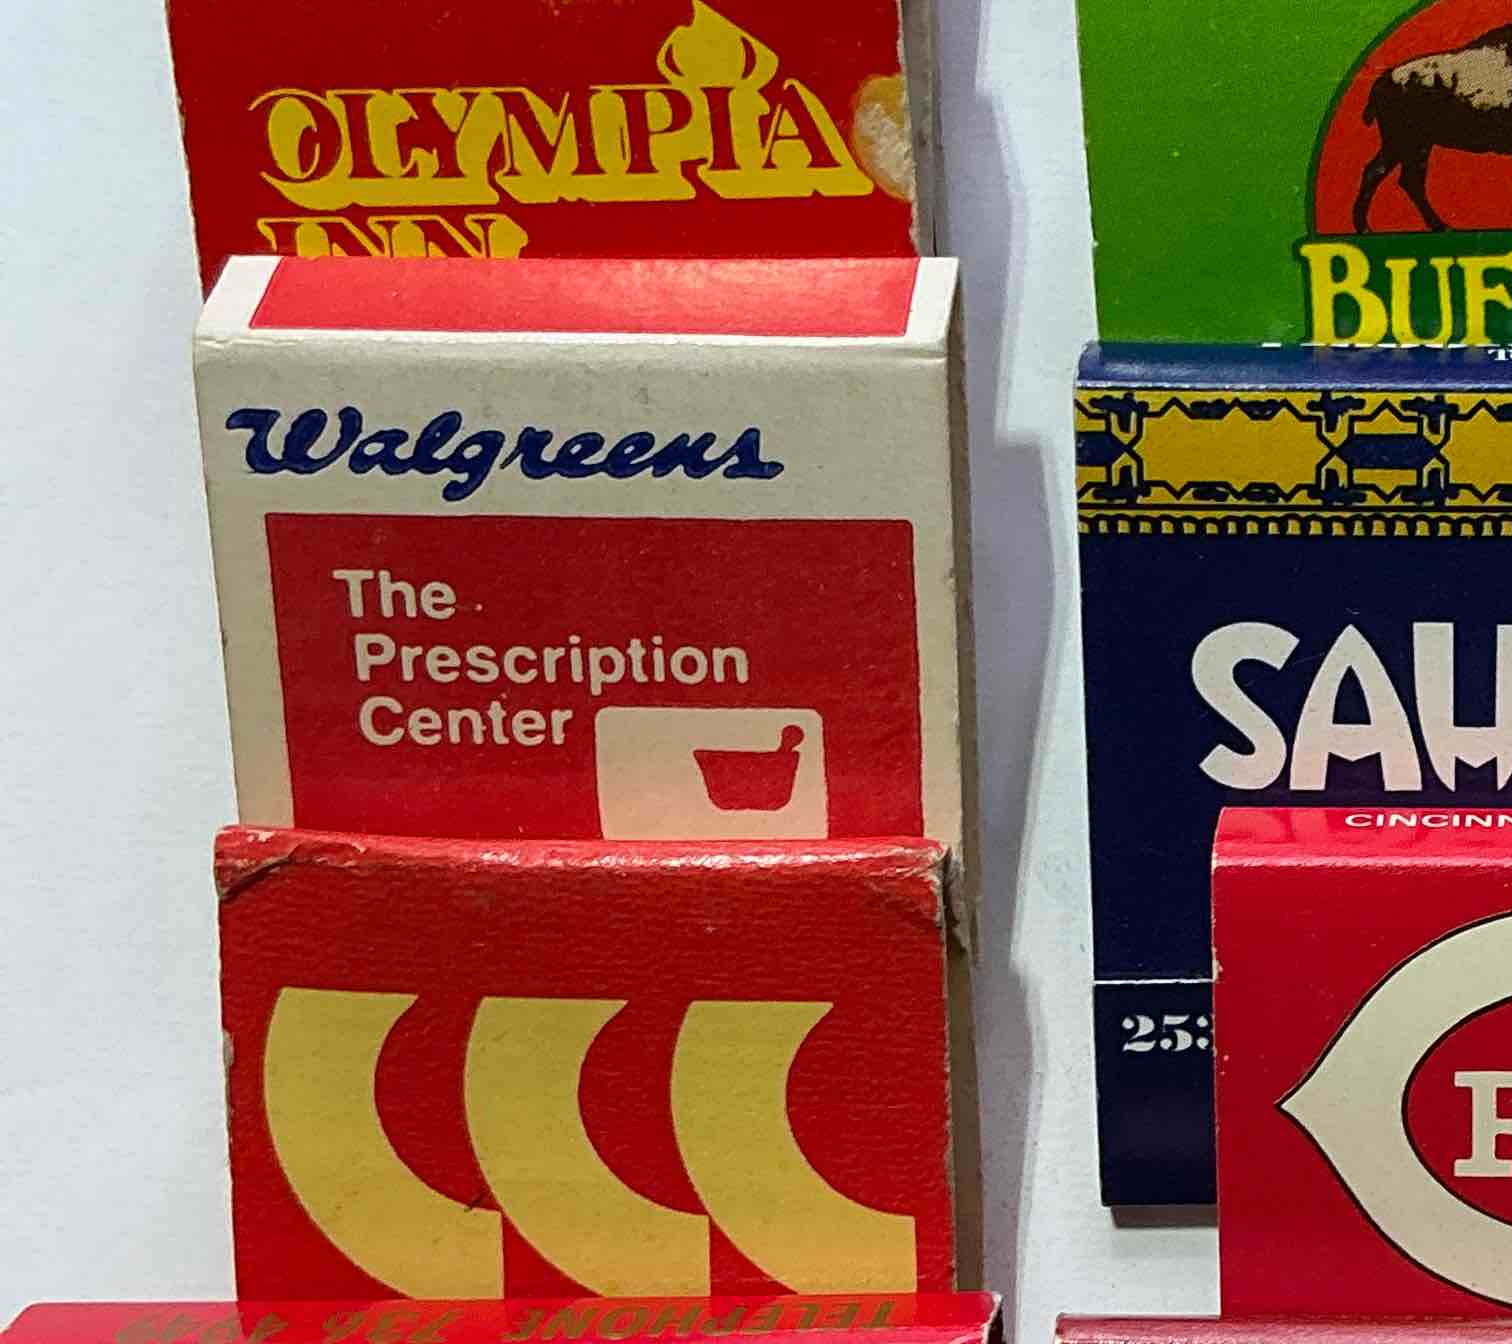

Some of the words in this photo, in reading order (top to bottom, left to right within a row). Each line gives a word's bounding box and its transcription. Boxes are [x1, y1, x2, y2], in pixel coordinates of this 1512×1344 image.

[248, 78, 875, 211] OLYMPIA
[223, 404, 786, 503] Walgreens
[332, 568, 459, 622] The
[353, 633, 751, 697] Prescription
[357, 697, 575, 749] Center
[502, 1298, 897, 1341] TELEPHONE
